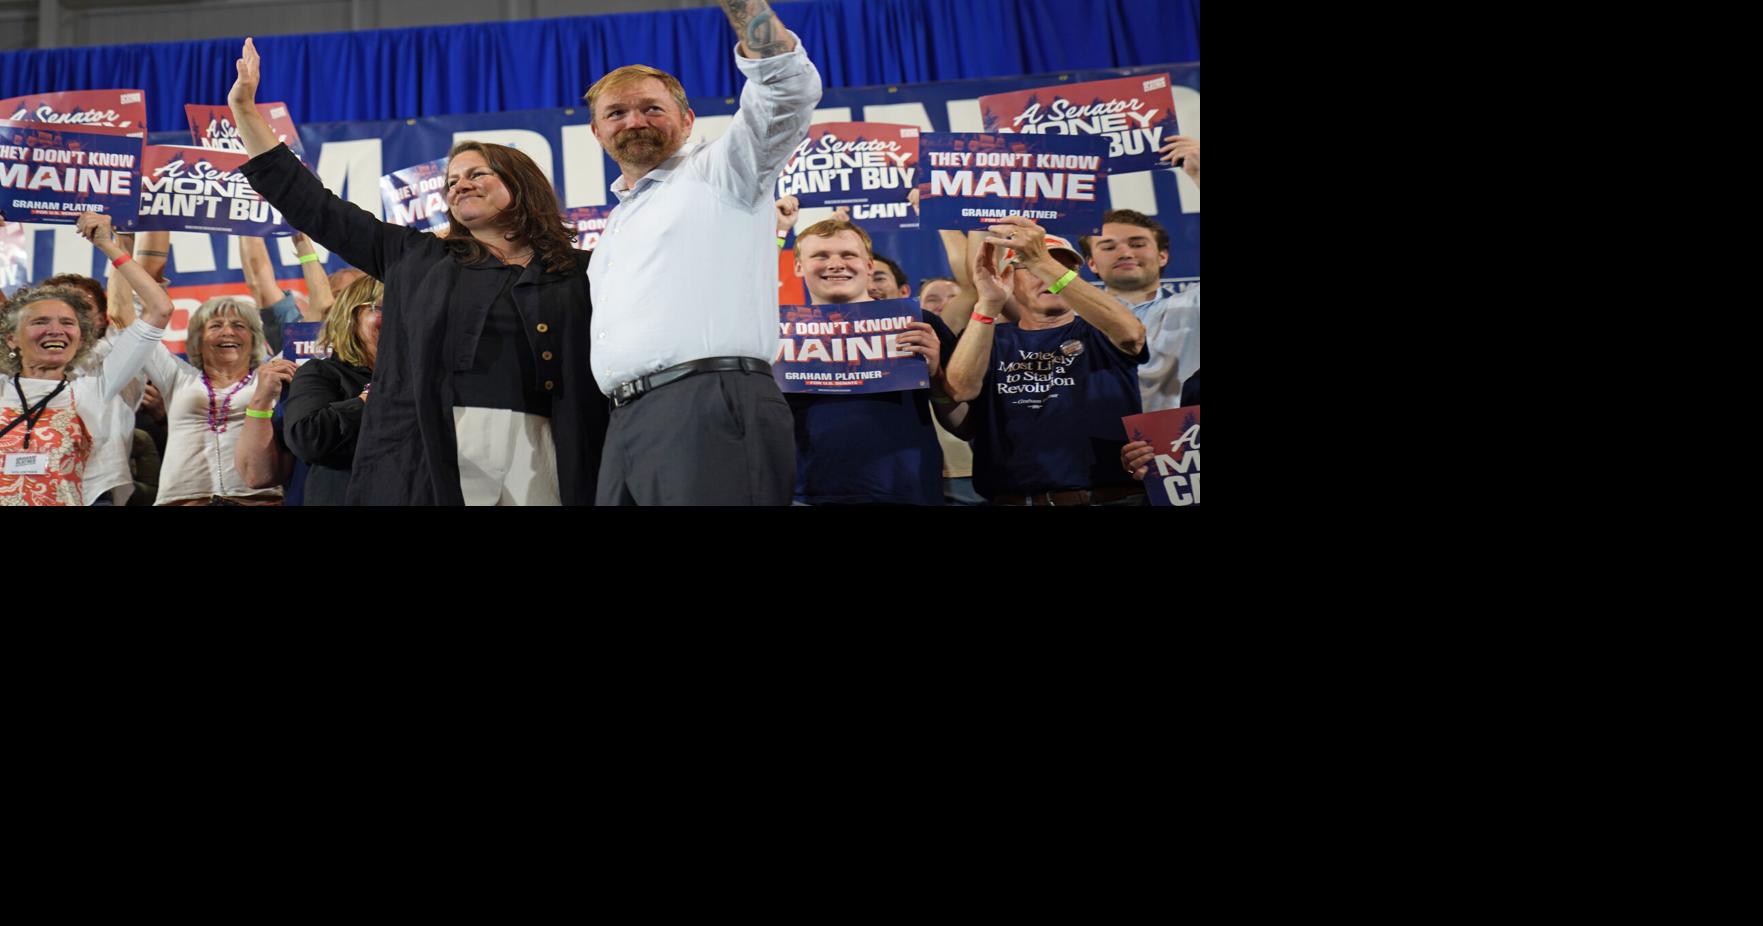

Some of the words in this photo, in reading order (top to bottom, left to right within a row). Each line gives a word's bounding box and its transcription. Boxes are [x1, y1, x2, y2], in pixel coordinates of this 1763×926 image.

[36, 106, 120, 124] Senator
[1013, 103, 1044, 127] A
[1047, 98, 1145, 122] Senator
[206, 119, 220, 138] A
[816, 134, 901, 154] Senator
[32, 148, 86, 165] DON'T
[88, 152, 134, 168] KNOW
[928, 152, 972, 167] THEY
[975, 152, 1033, 168] DON'T
[1036, 154, 1100, 170] KNOW
[0, 161, 132, 195] MAINE
[152, 160, 185, 178] A
[141, 176, 259, 200] MONE
[778, 168, 853, 198] CAN'T
[861, 167, 915, 190] BUY
[930, 170, 1097, 201] MAINE
[12, 199, 60, 211] GRAHAM
[62, 202, 104, 213] PLATNER
[138, 192, 222, 218] CAN'T
[961, 208, 1006, 217] GRAHAM
[796, 321, 849, 335] DON'T
[854, 315, 913, 333] KNOW
[785, 372, 833, 381] GRAHAM
[835, 370, 882, 380] PLATNER
[998, 361, 1034, 373] Most
[1006, 373, 1020, 383] to
[1055, 366, 1065, 374] a
